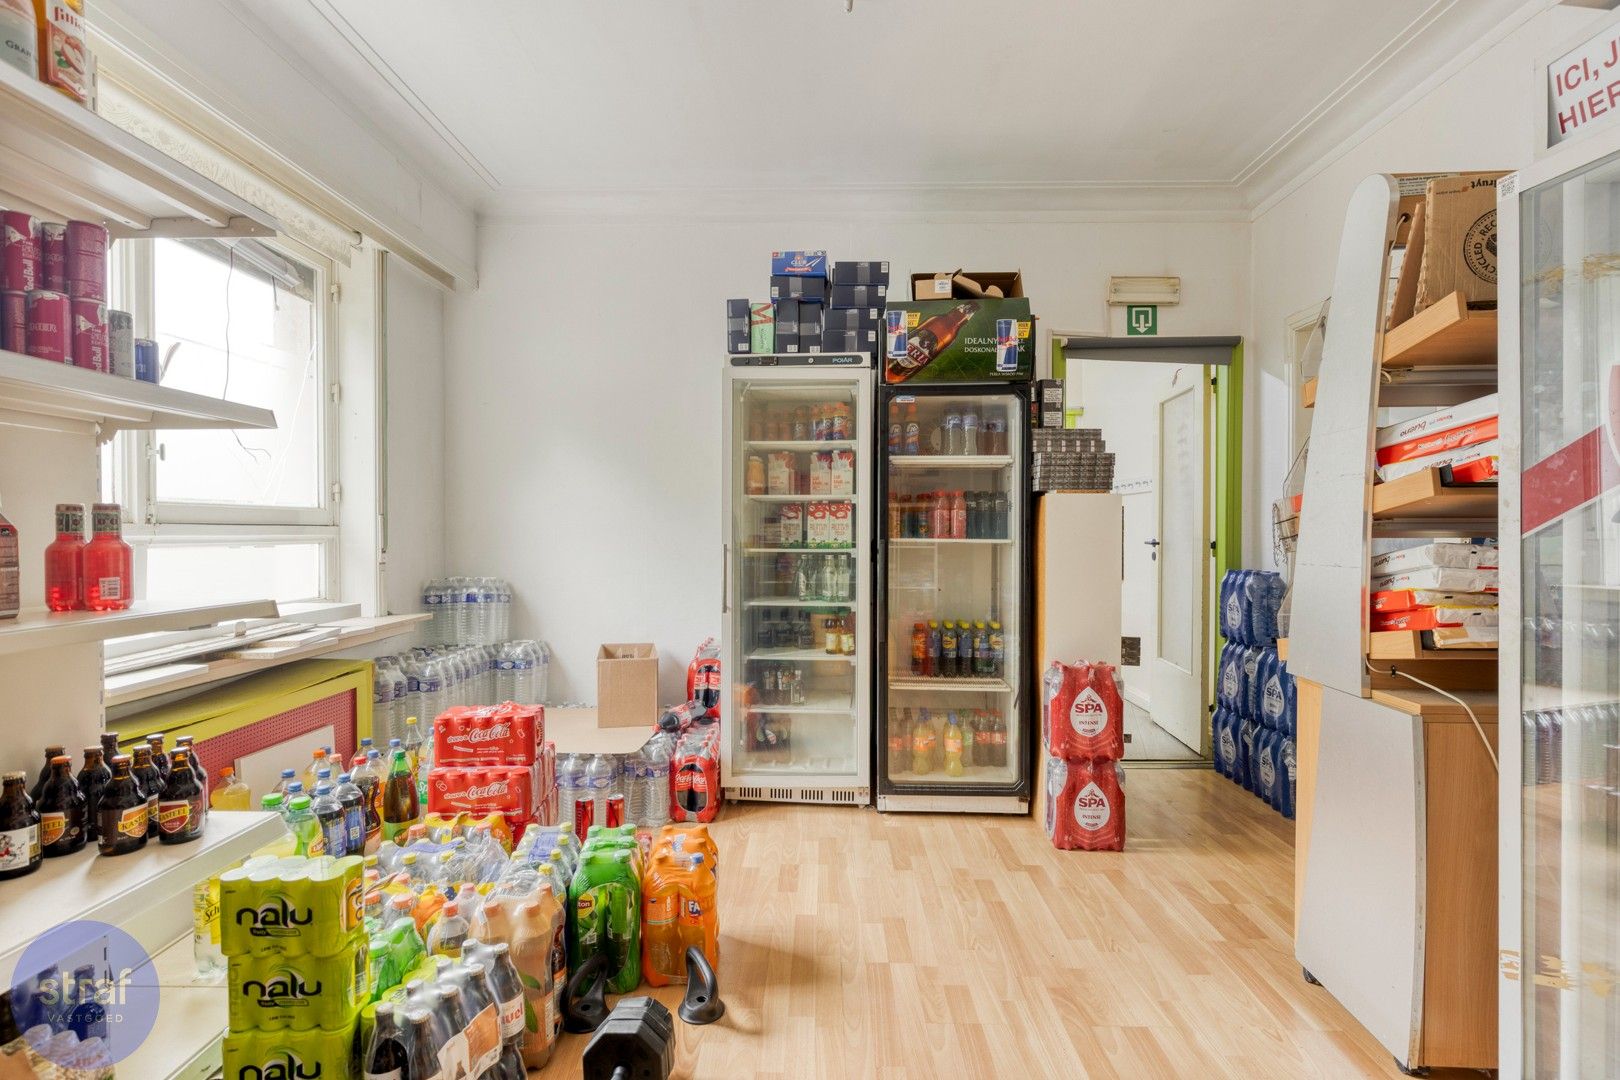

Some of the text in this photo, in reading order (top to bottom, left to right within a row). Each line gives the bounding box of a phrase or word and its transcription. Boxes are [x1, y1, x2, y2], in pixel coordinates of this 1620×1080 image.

[1556, 37, 1620, 97] ICI, J
[1266, 687, 1282, 700] SPA
[1075, 703, 1103, 713] SPA
[1079, 797, 1106, 807] SPA
[205, 907, 220, 921] Sch
[236, 898, 313, 928] nalu
[242, 971, 322, 998] nalu
[239, 1052, 322, 1080] nalu
